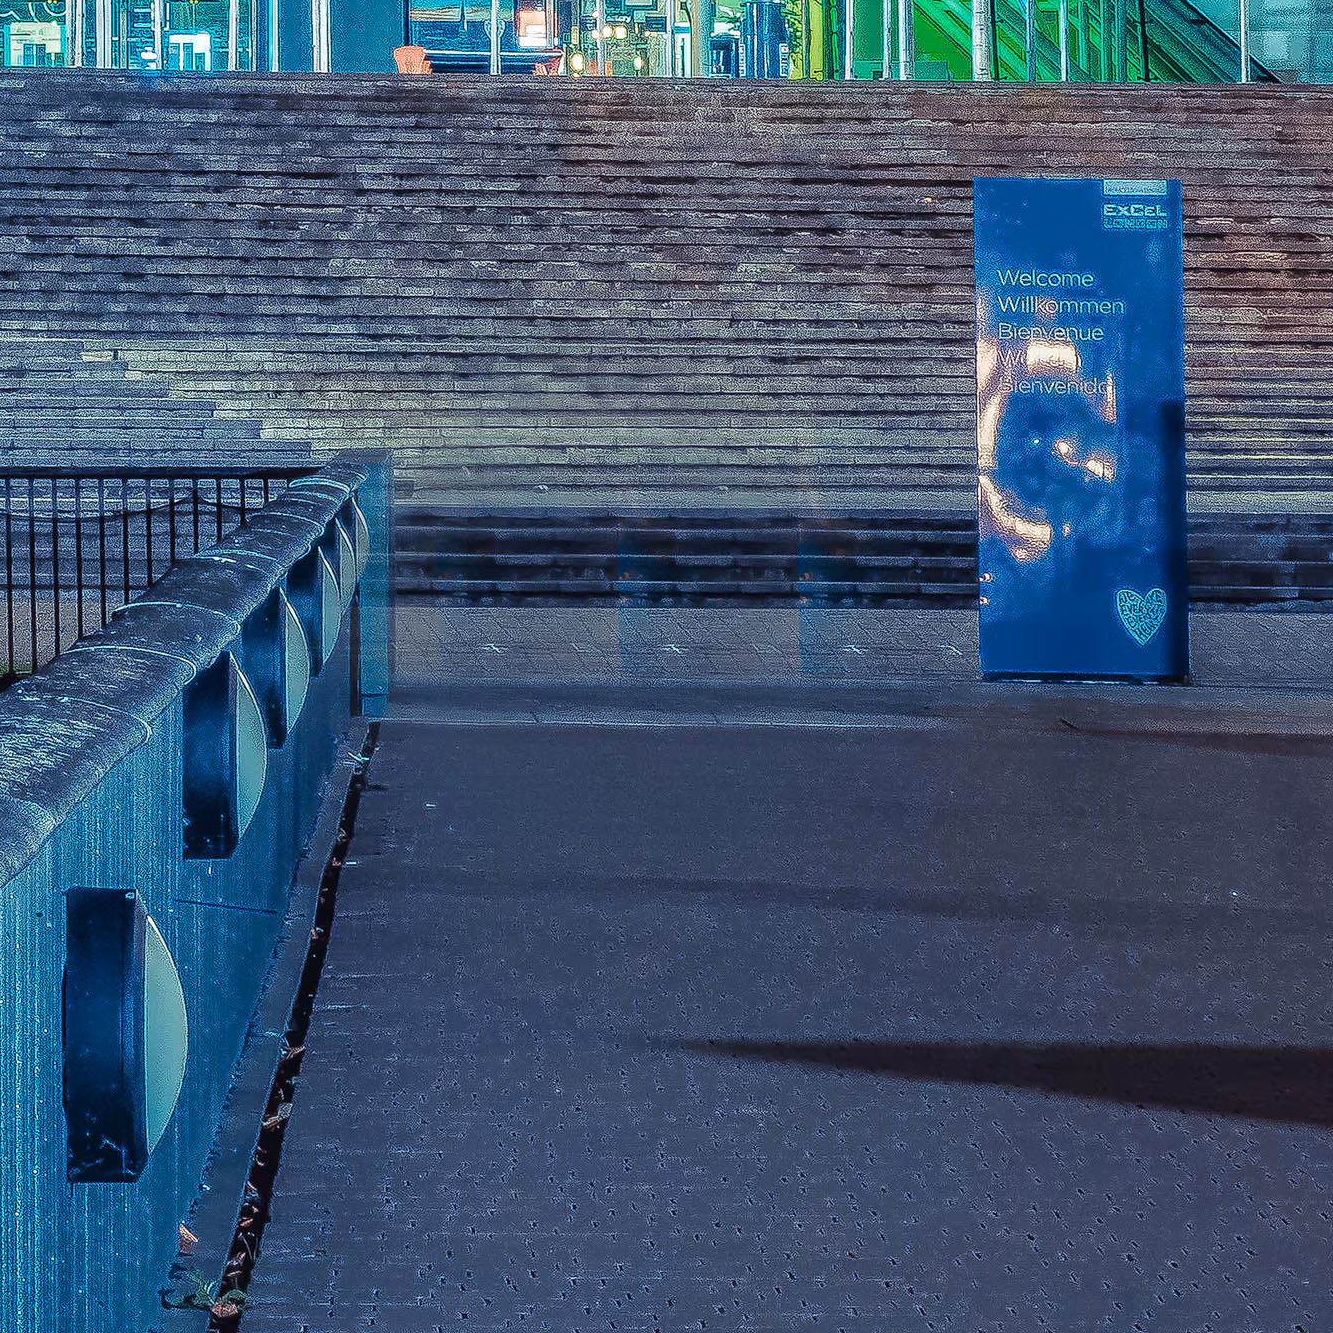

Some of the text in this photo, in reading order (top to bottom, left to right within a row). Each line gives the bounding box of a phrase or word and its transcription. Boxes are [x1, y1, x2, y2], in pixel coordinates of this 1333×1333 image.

[997, 269, 1094, 287] Welcome
[997, 296, 1125, 314] Willkommen
[998, 322, 1104, 341] Bienvenue
